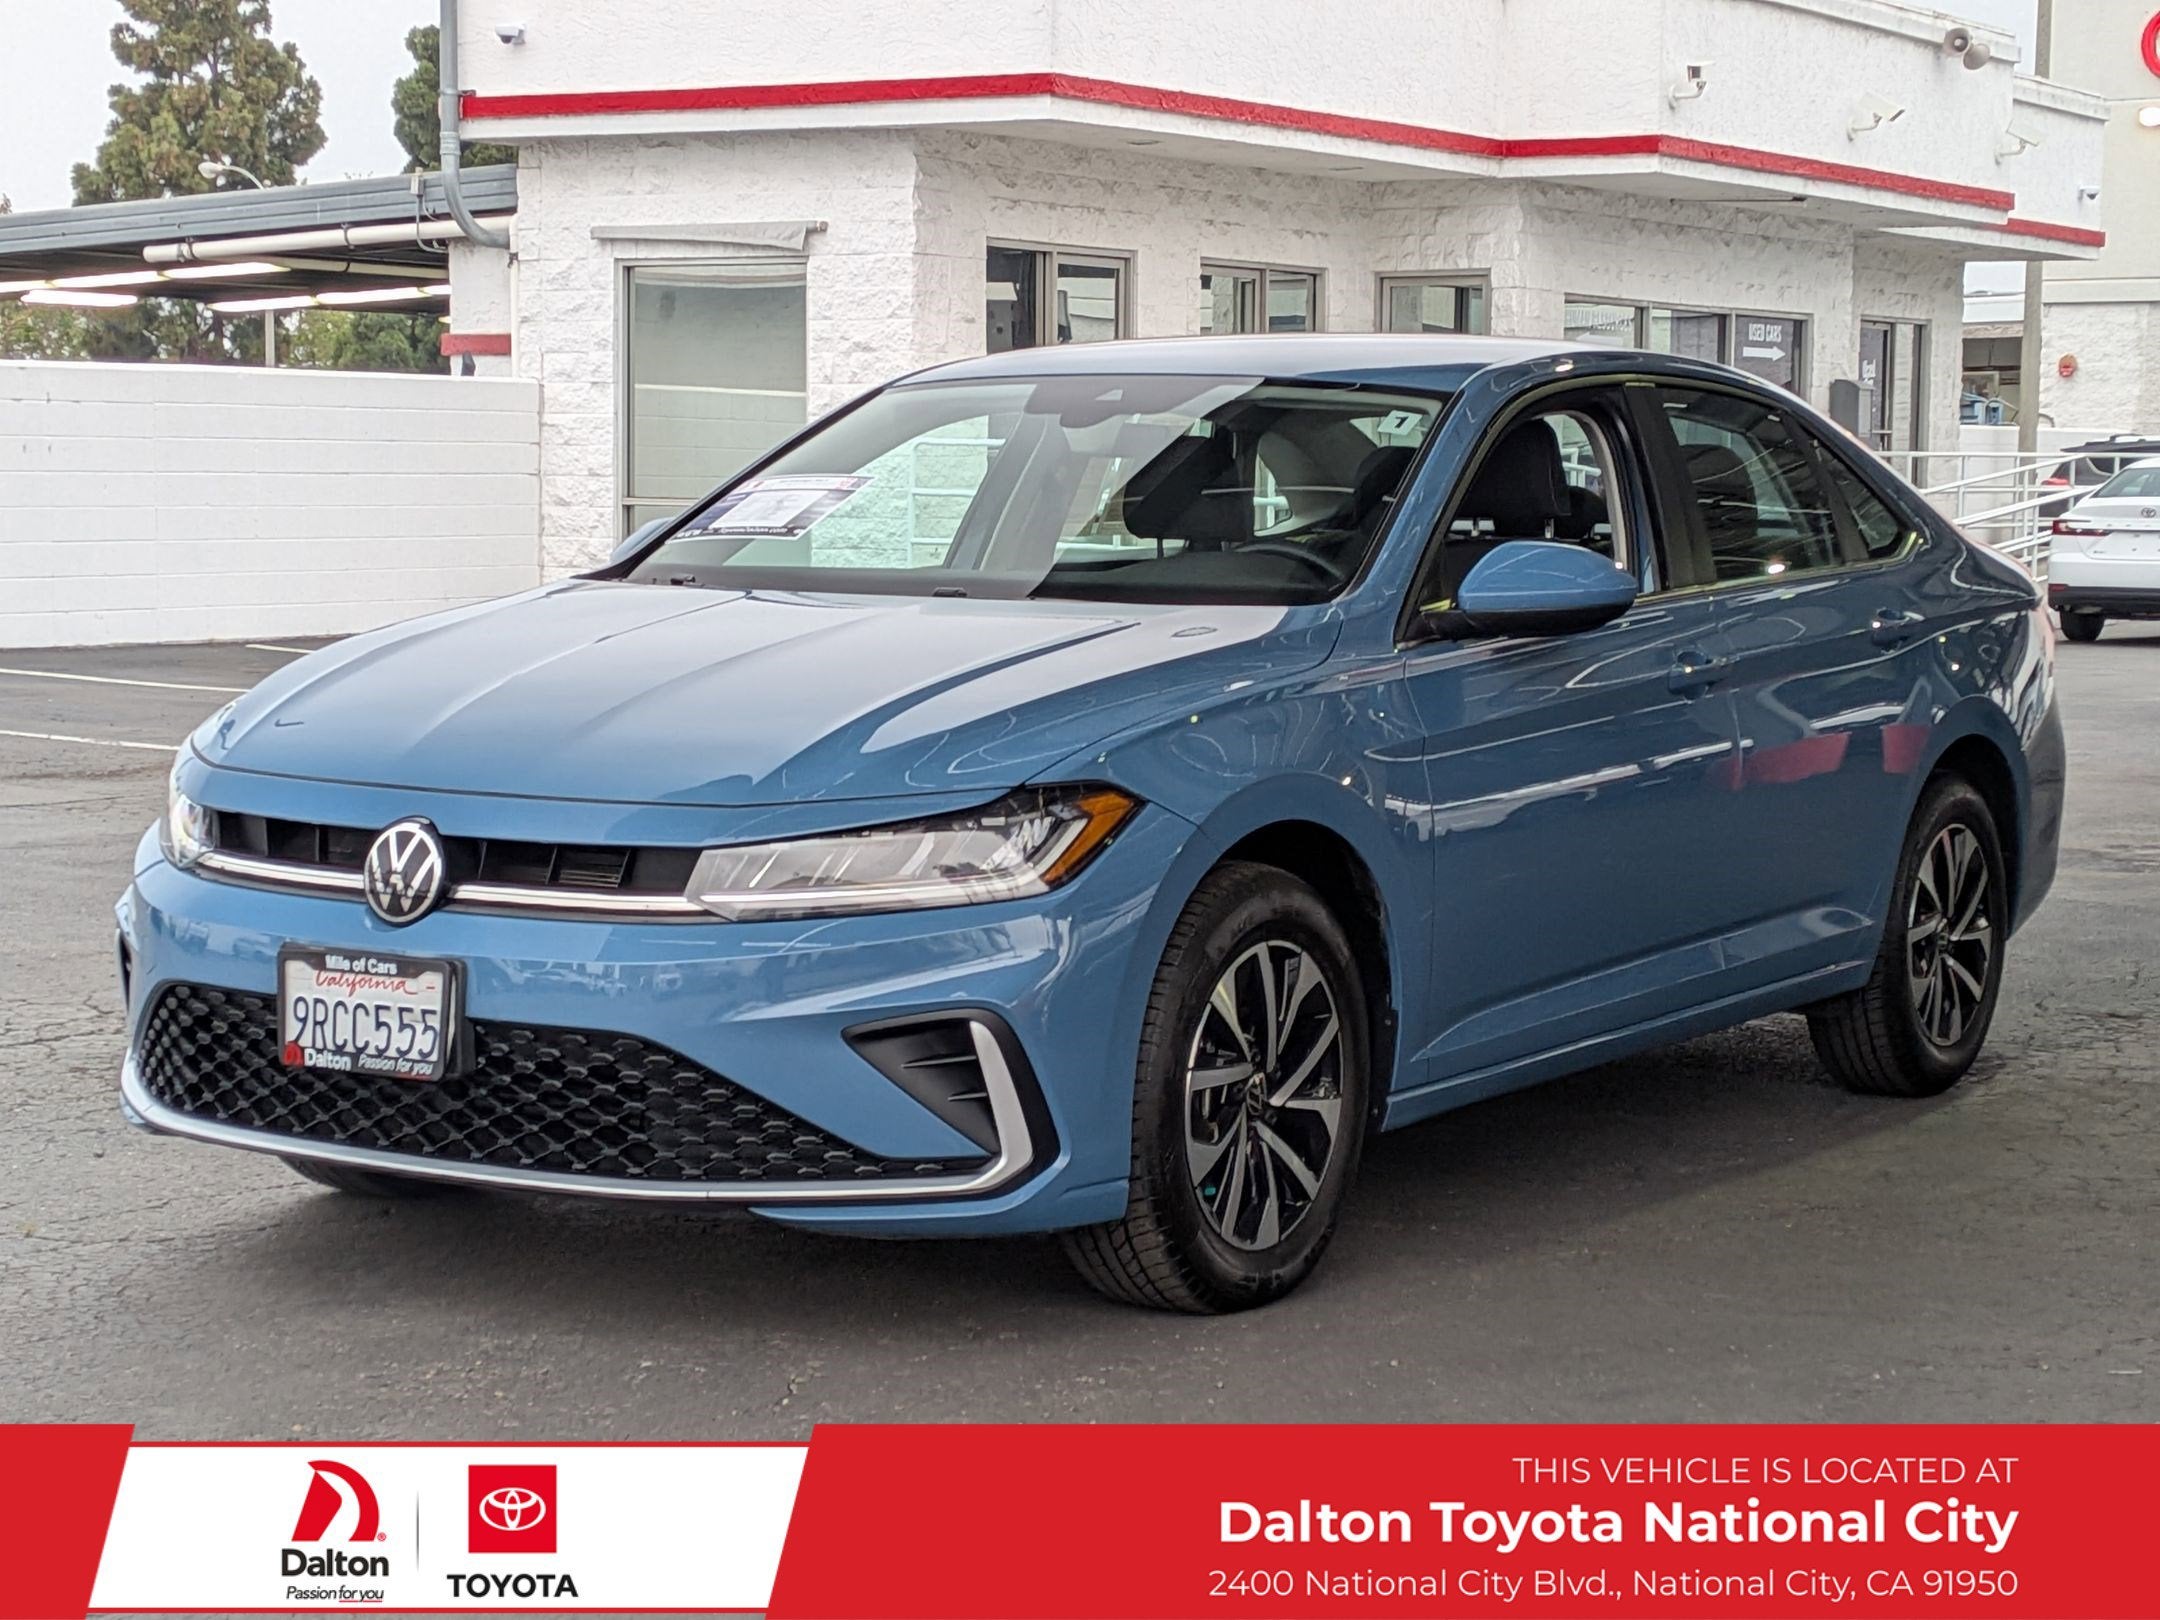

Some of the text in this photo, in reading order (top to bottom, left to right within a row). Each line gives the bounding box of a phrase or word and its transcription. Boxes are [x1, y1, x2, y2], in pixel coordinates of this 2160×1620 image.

[1748, 323, 1782, 342] USED CARS
[325, 954, 398, 975] Mile of Cars
[316, 968, 418, 997] California
[293, 996, 439, 1059] 9RCC555
[304, 1048, 434, 1075] Dalton Passion for you
